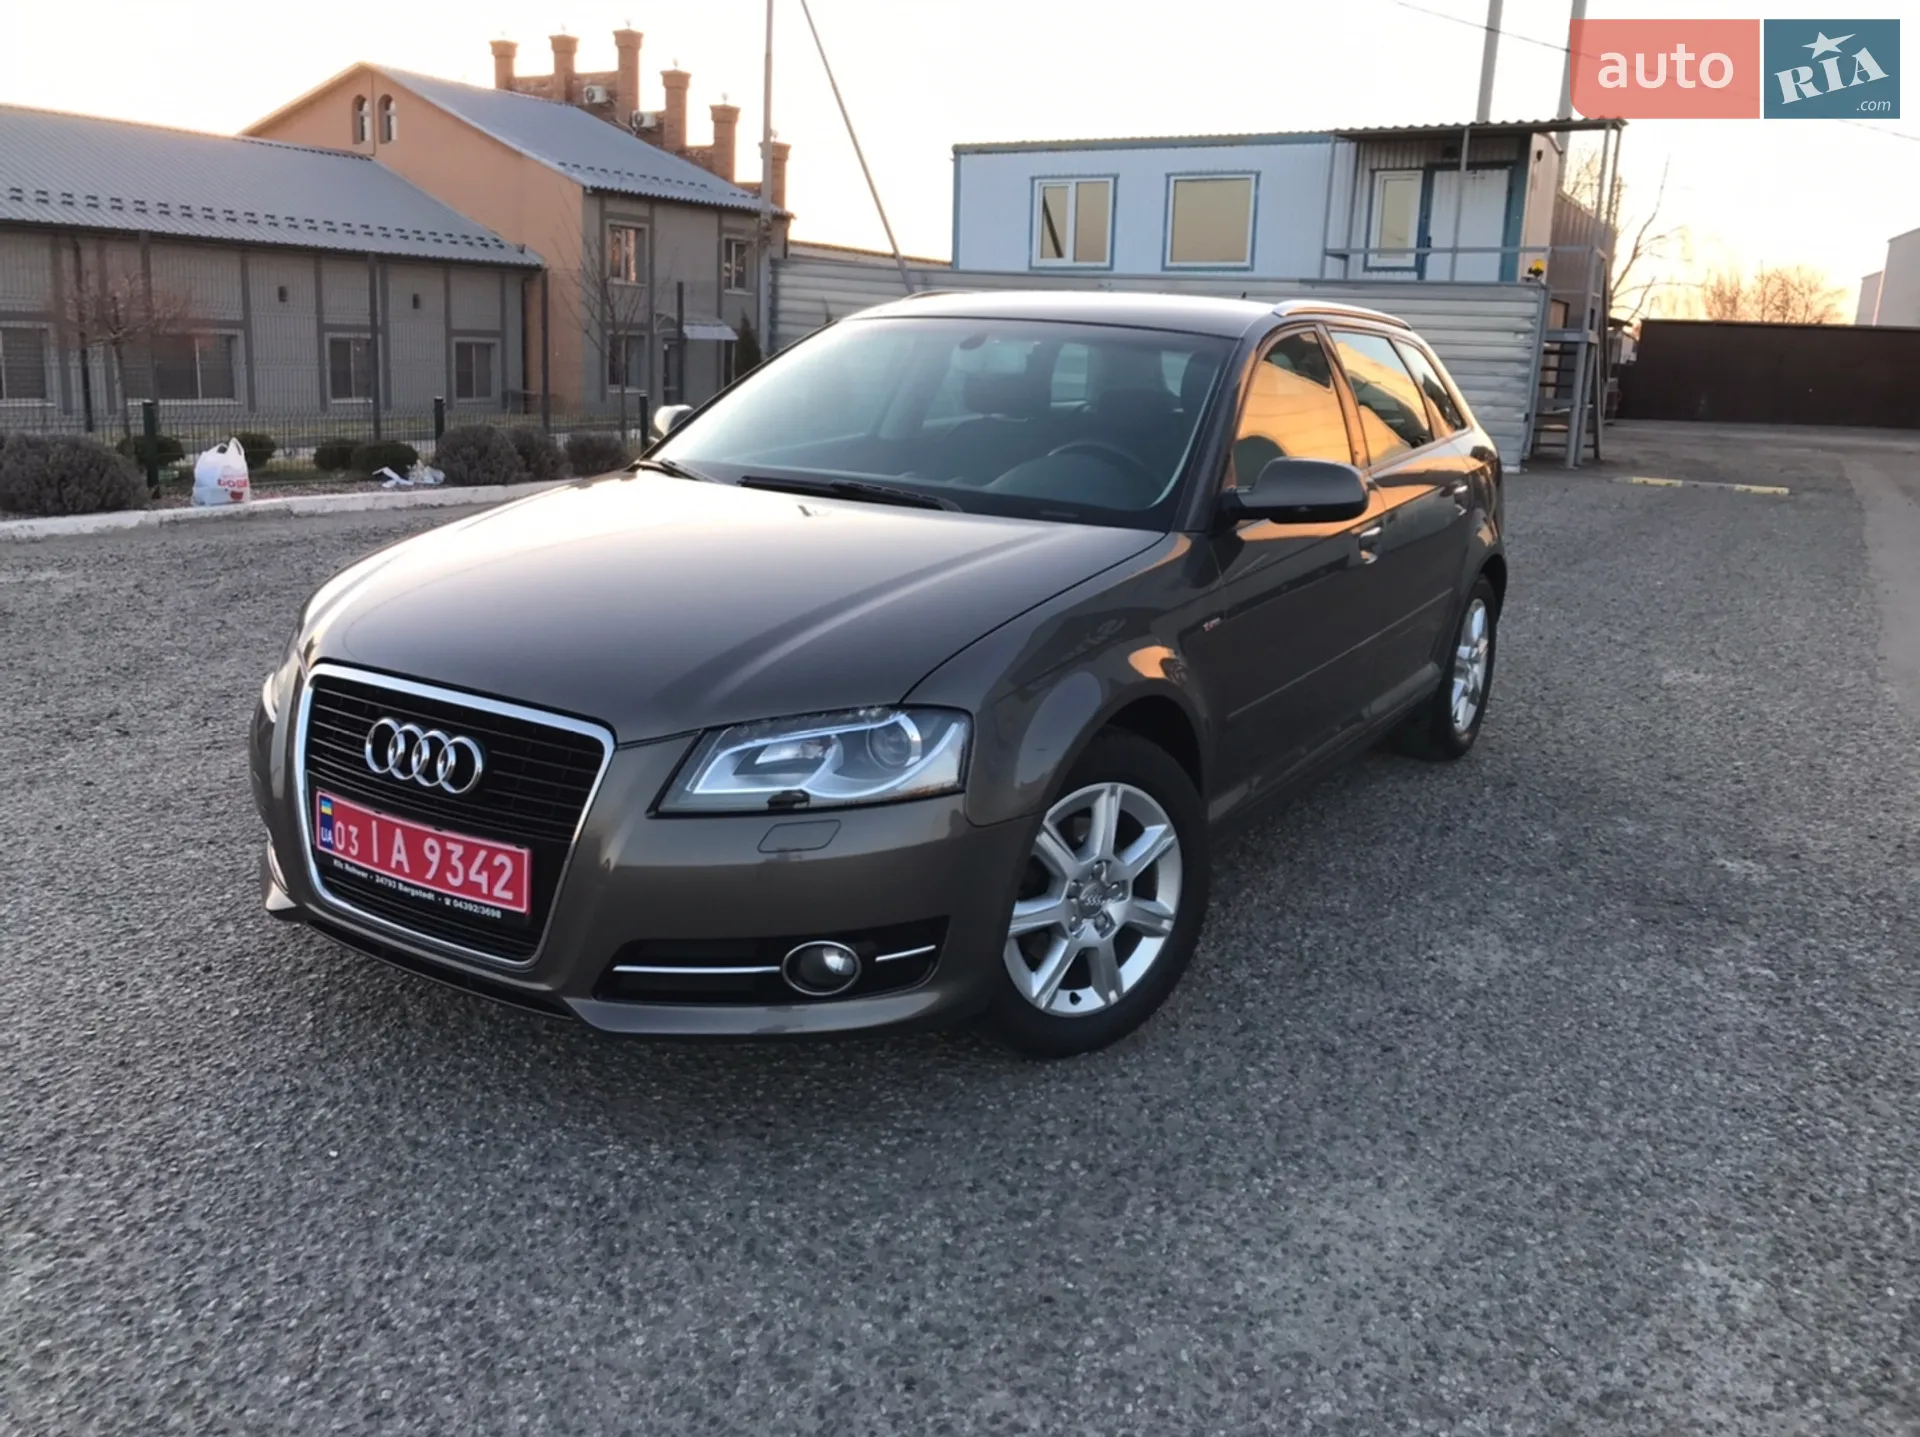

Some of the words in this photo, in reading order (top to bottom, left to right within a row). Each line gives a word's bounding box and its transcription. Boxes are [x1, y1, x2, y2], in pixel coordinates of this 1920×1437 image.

[321, 826, 334, 845] UA
[335, 820, 359, 857] 03
[371, 819, 411, 874] IA
[423, 837, 513, 901] 9342
